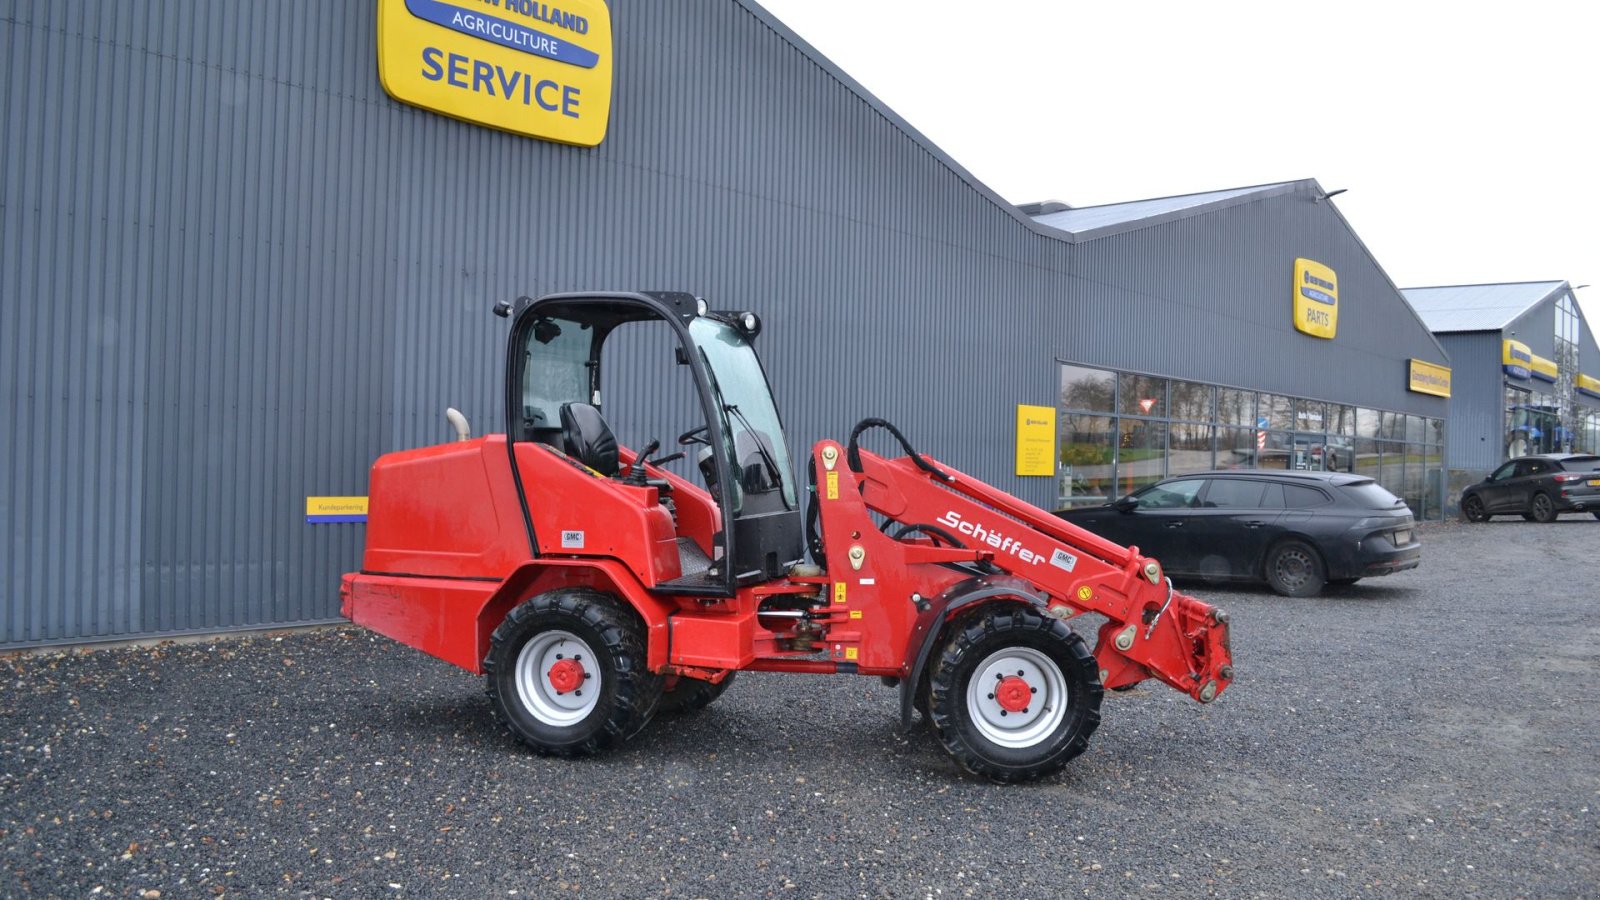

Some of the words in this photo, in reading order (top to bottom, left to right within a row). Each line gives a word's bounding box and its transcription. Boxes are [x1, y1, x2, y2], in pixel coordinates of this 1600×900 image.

[452, 11, 558, 55] AGRICULTURE
[505, 0, 589, 35] HOLLAND
[421, 46, 581, 119] SERVICE
[1306, 307, 1329, 327] PARTS
[936, 510, 1046, 567] Schäffer
